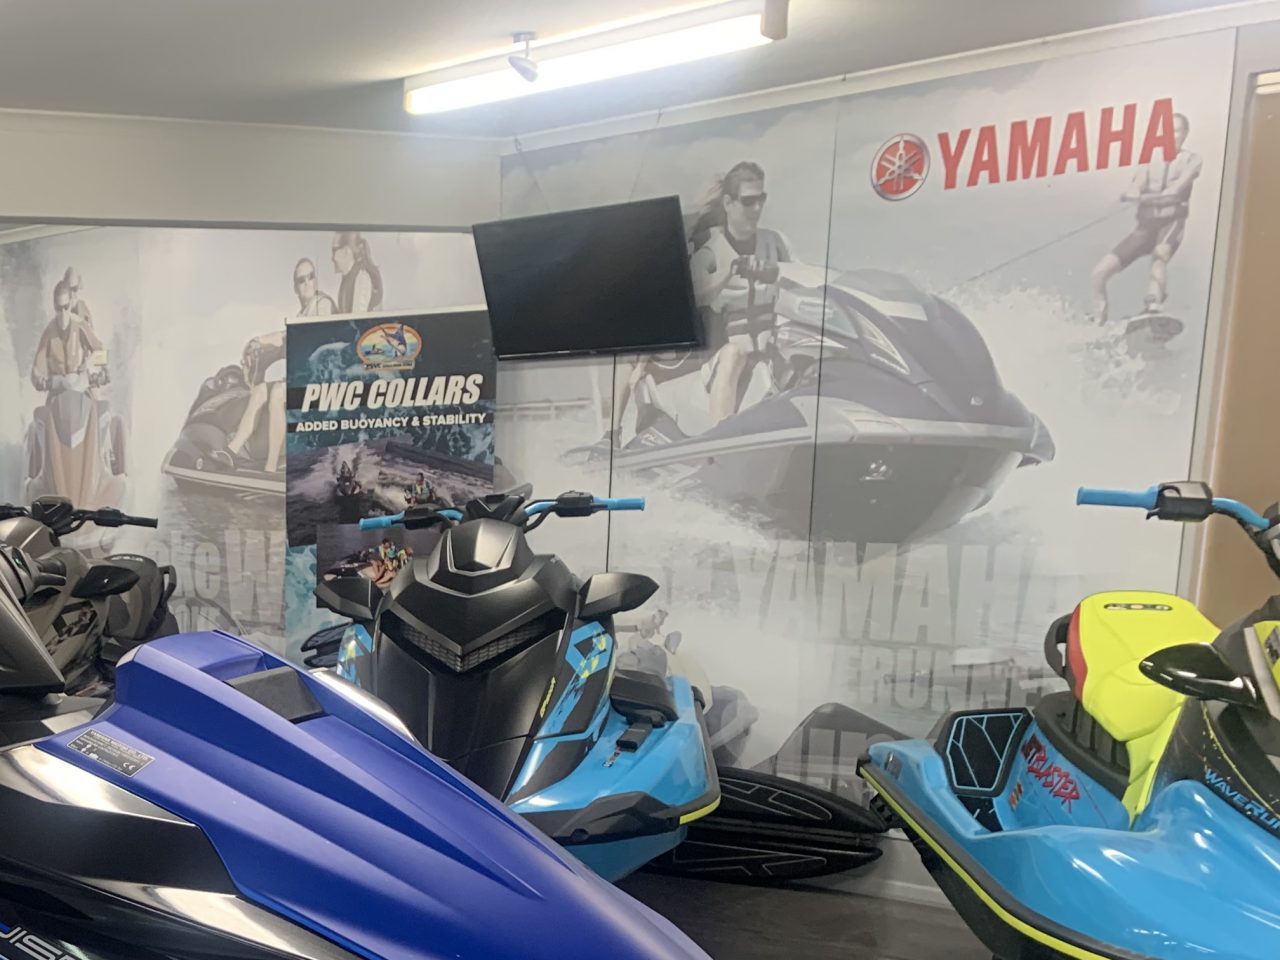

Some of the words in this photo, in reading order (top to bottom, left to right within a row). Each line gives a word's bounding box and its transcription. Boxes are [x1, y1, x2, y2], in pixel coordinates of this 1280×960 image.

[937, 97, 1178, 190] YAMAHA
[301, 380, 365, 413] PWC
[367, 373, 484, 410] COLLARS
[296, 420, 338, 433] ADDED
[340, 416, 409, 431] BUOYANCY
[411, 416, 420, 427] &
[422, 413, 487, 427] STABILITY
